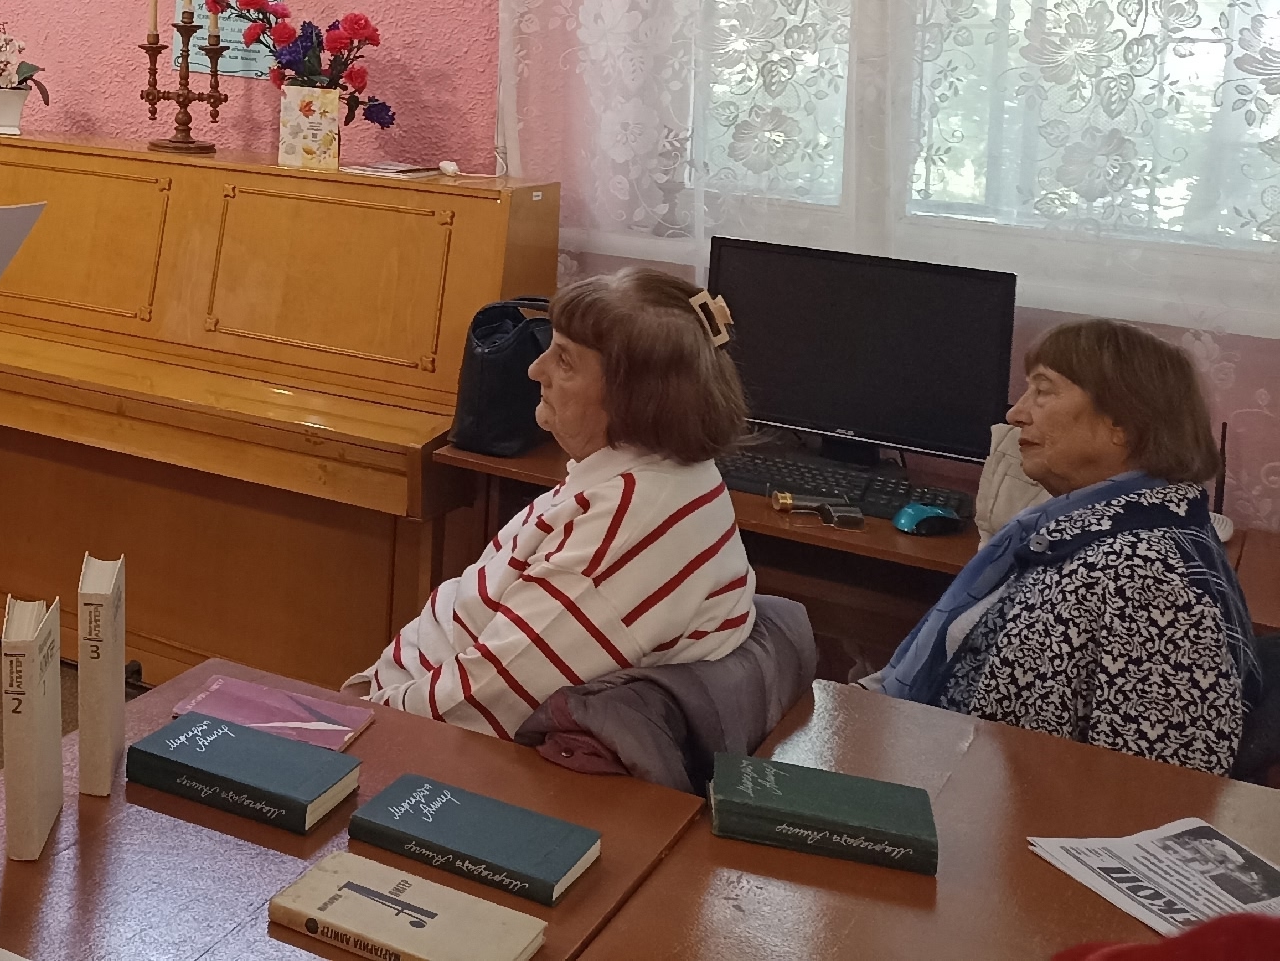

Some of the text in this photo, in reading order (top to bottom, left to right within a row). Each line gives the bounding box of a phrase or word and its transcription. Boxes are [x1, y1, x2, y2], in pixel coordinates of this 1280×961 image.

[89, 644, 101, 660] 3
[11, 697, 23, 715] 2
[320, 925, 352, 946] АЛИГЕР
